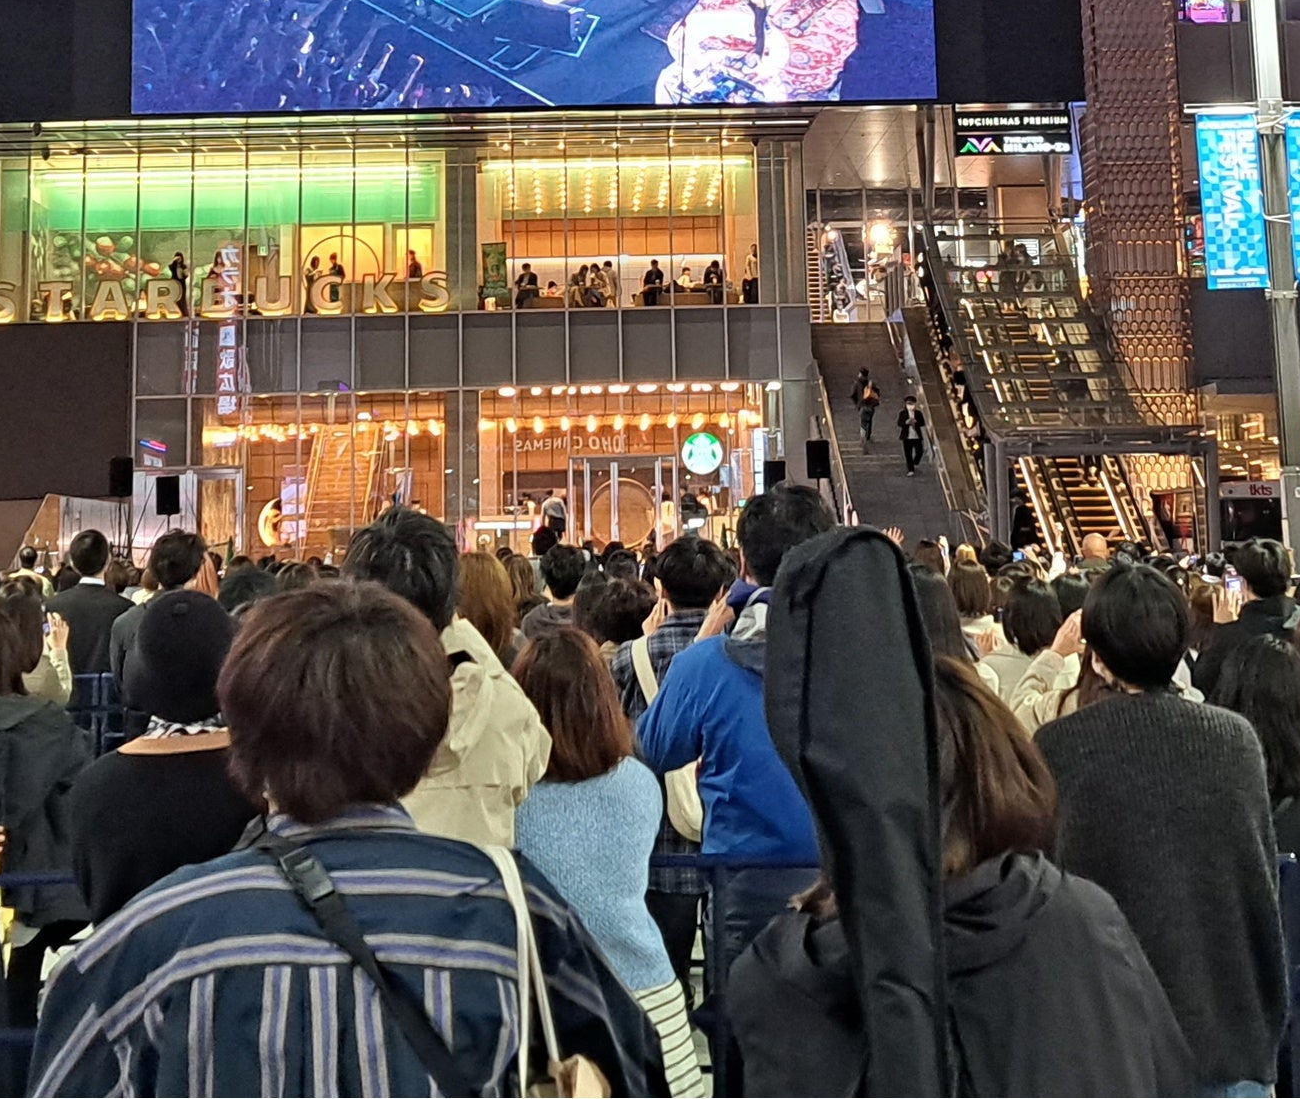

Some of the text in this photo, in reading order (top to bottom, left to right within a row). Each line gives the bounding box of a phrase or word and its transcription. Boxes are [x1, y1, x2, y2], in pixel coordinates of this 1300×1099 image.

[1023, 115, 1069, 126] PREMIUM
[1236, 128, 1259, 181] BLUE
[1217, 128, 1246, 227] FESTIVAL
[1250, 484, 1273, 496] tkts
